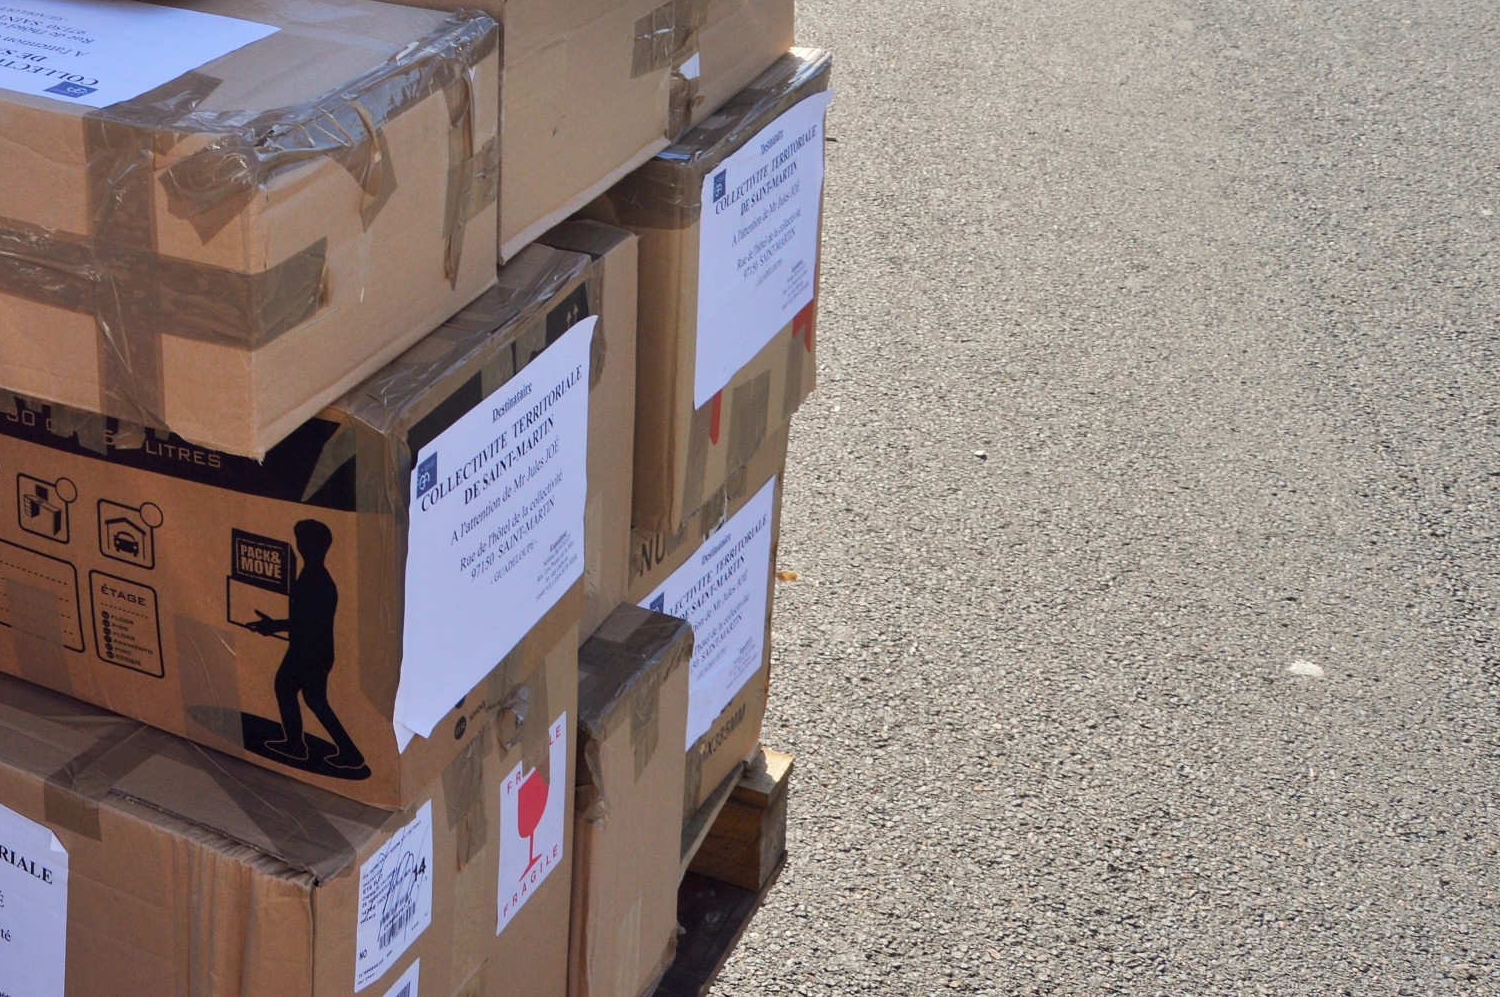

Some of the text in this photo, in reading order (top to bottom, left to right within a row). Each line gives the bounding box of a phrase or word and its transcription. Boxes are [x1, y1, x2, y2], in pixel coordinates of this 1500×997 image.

[492, 381, 532, 423] Destinataire
[6, 408, 35, 427] 30
[422, 365, 582, 513] COLLECTIVITE TERRITORIALE
[145, 442, 222, 468] LITRES
[464, 418, 555, 506] DE SAINT-MARTIN
[241, 544, 281, 565] PACK&
[241, 558, 282, 579] MOVE
[101, 583, 147, 606] ÉTAGE
[111, 616, 134, 625] FLOOR
[113, 639, 153, 655] PAVIMENTO
[503, 845, 558, 917] FRAGILE
